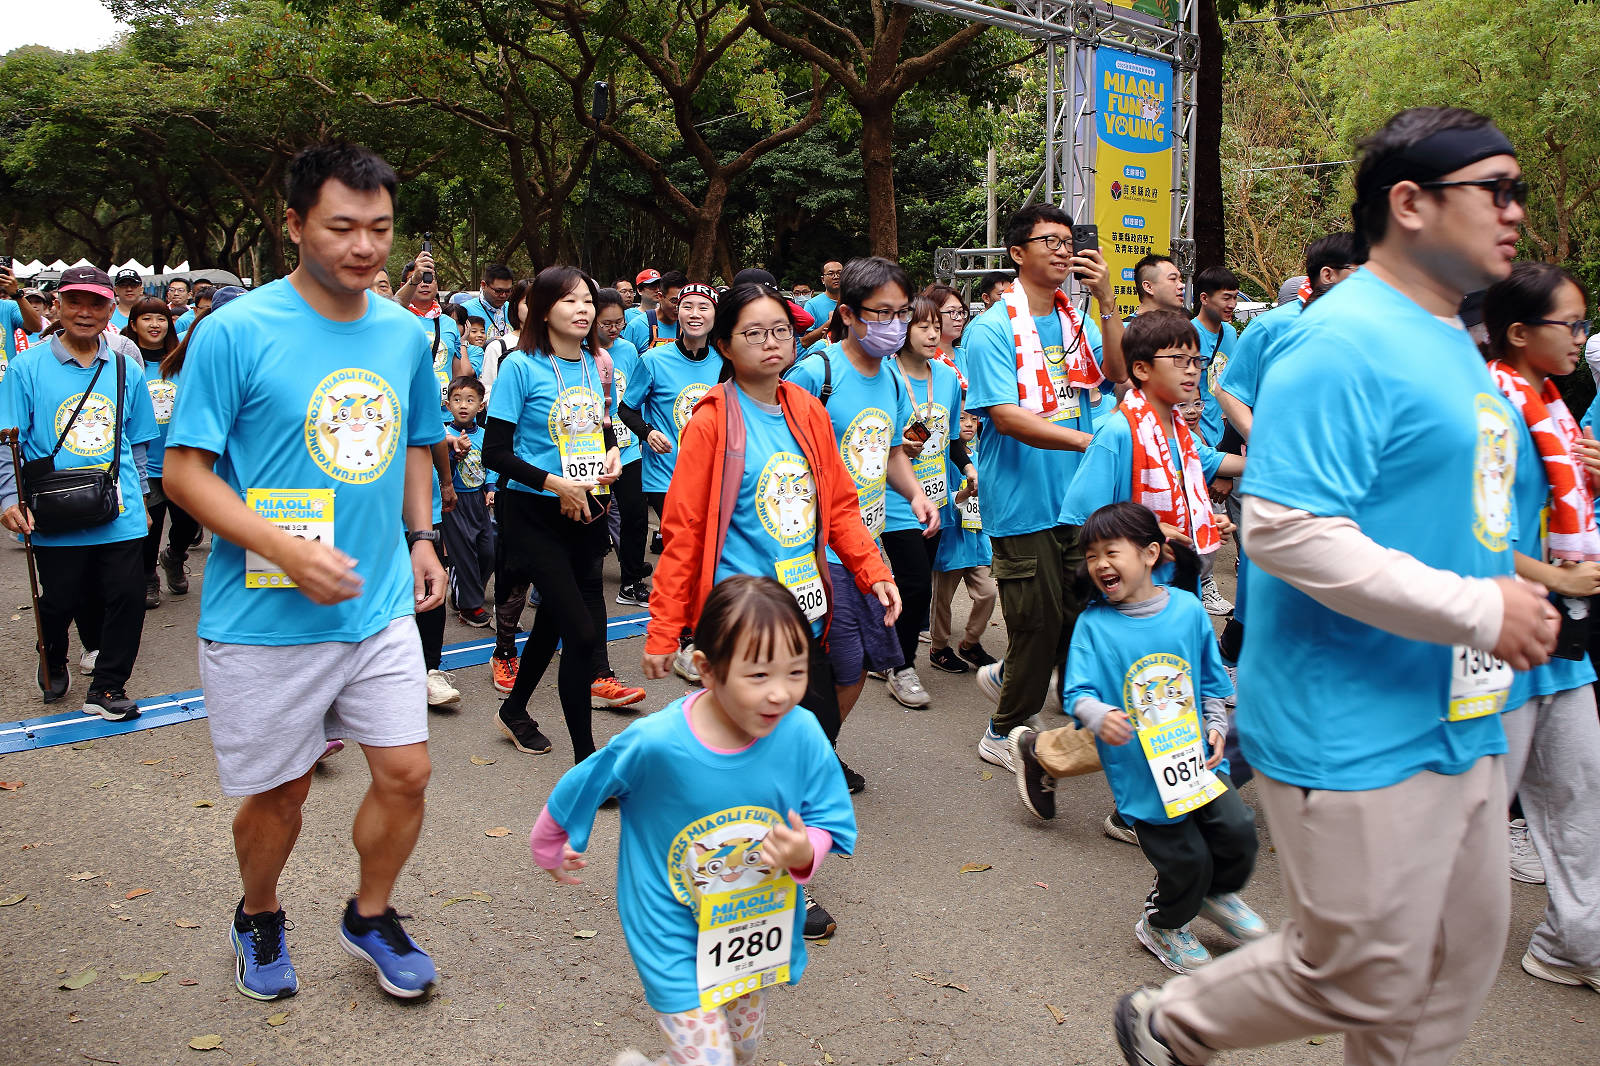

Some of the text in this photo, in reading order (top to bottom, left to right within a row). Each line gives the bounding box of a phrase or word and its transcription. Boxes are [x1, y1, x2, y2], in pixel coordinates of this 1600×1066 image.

[1103, 70, 1165, 102] MIAOLI
[1107, 92, 1141, 117] FUN
[1103, 112, 1165, 143] YOUNG
[320, 371, 356, 394] MIAOLI
[358, 371, 380, 386] FUN
[307, 429, 331, 469] YOUNG
[569, 461, 605, 478] 0872
[924, 480, 945, 497] 832
[255, 499, 312, 510] MIAOLI
[281, 510, 324, 519] YOUNG
[758, 501, 778, 535] YOUNG
[783, 562, 814, 578] MIAOLI
[785, 575, 800, 586] FUN
[798, 588, 823, 612] 308
[1127, 656, 1159, 683] MIAOLI
[1160, 655, 1180, 666] FUN
[1149, 724, 1191, 747] MIAOLI
[1153, 741, 1174, 754] FUN
[1163, 752, 1205, 787] 0874
[671, 837, 688, 869] 2025
[686, 810, 742, 840] MIAOLI
[743, 809, 770, 823] FUN
[709, 899, 785, 926] FUN YOUNG
[711, 891, 775, 917] MIAOLI
[708, 926, 782, 967] 1280
